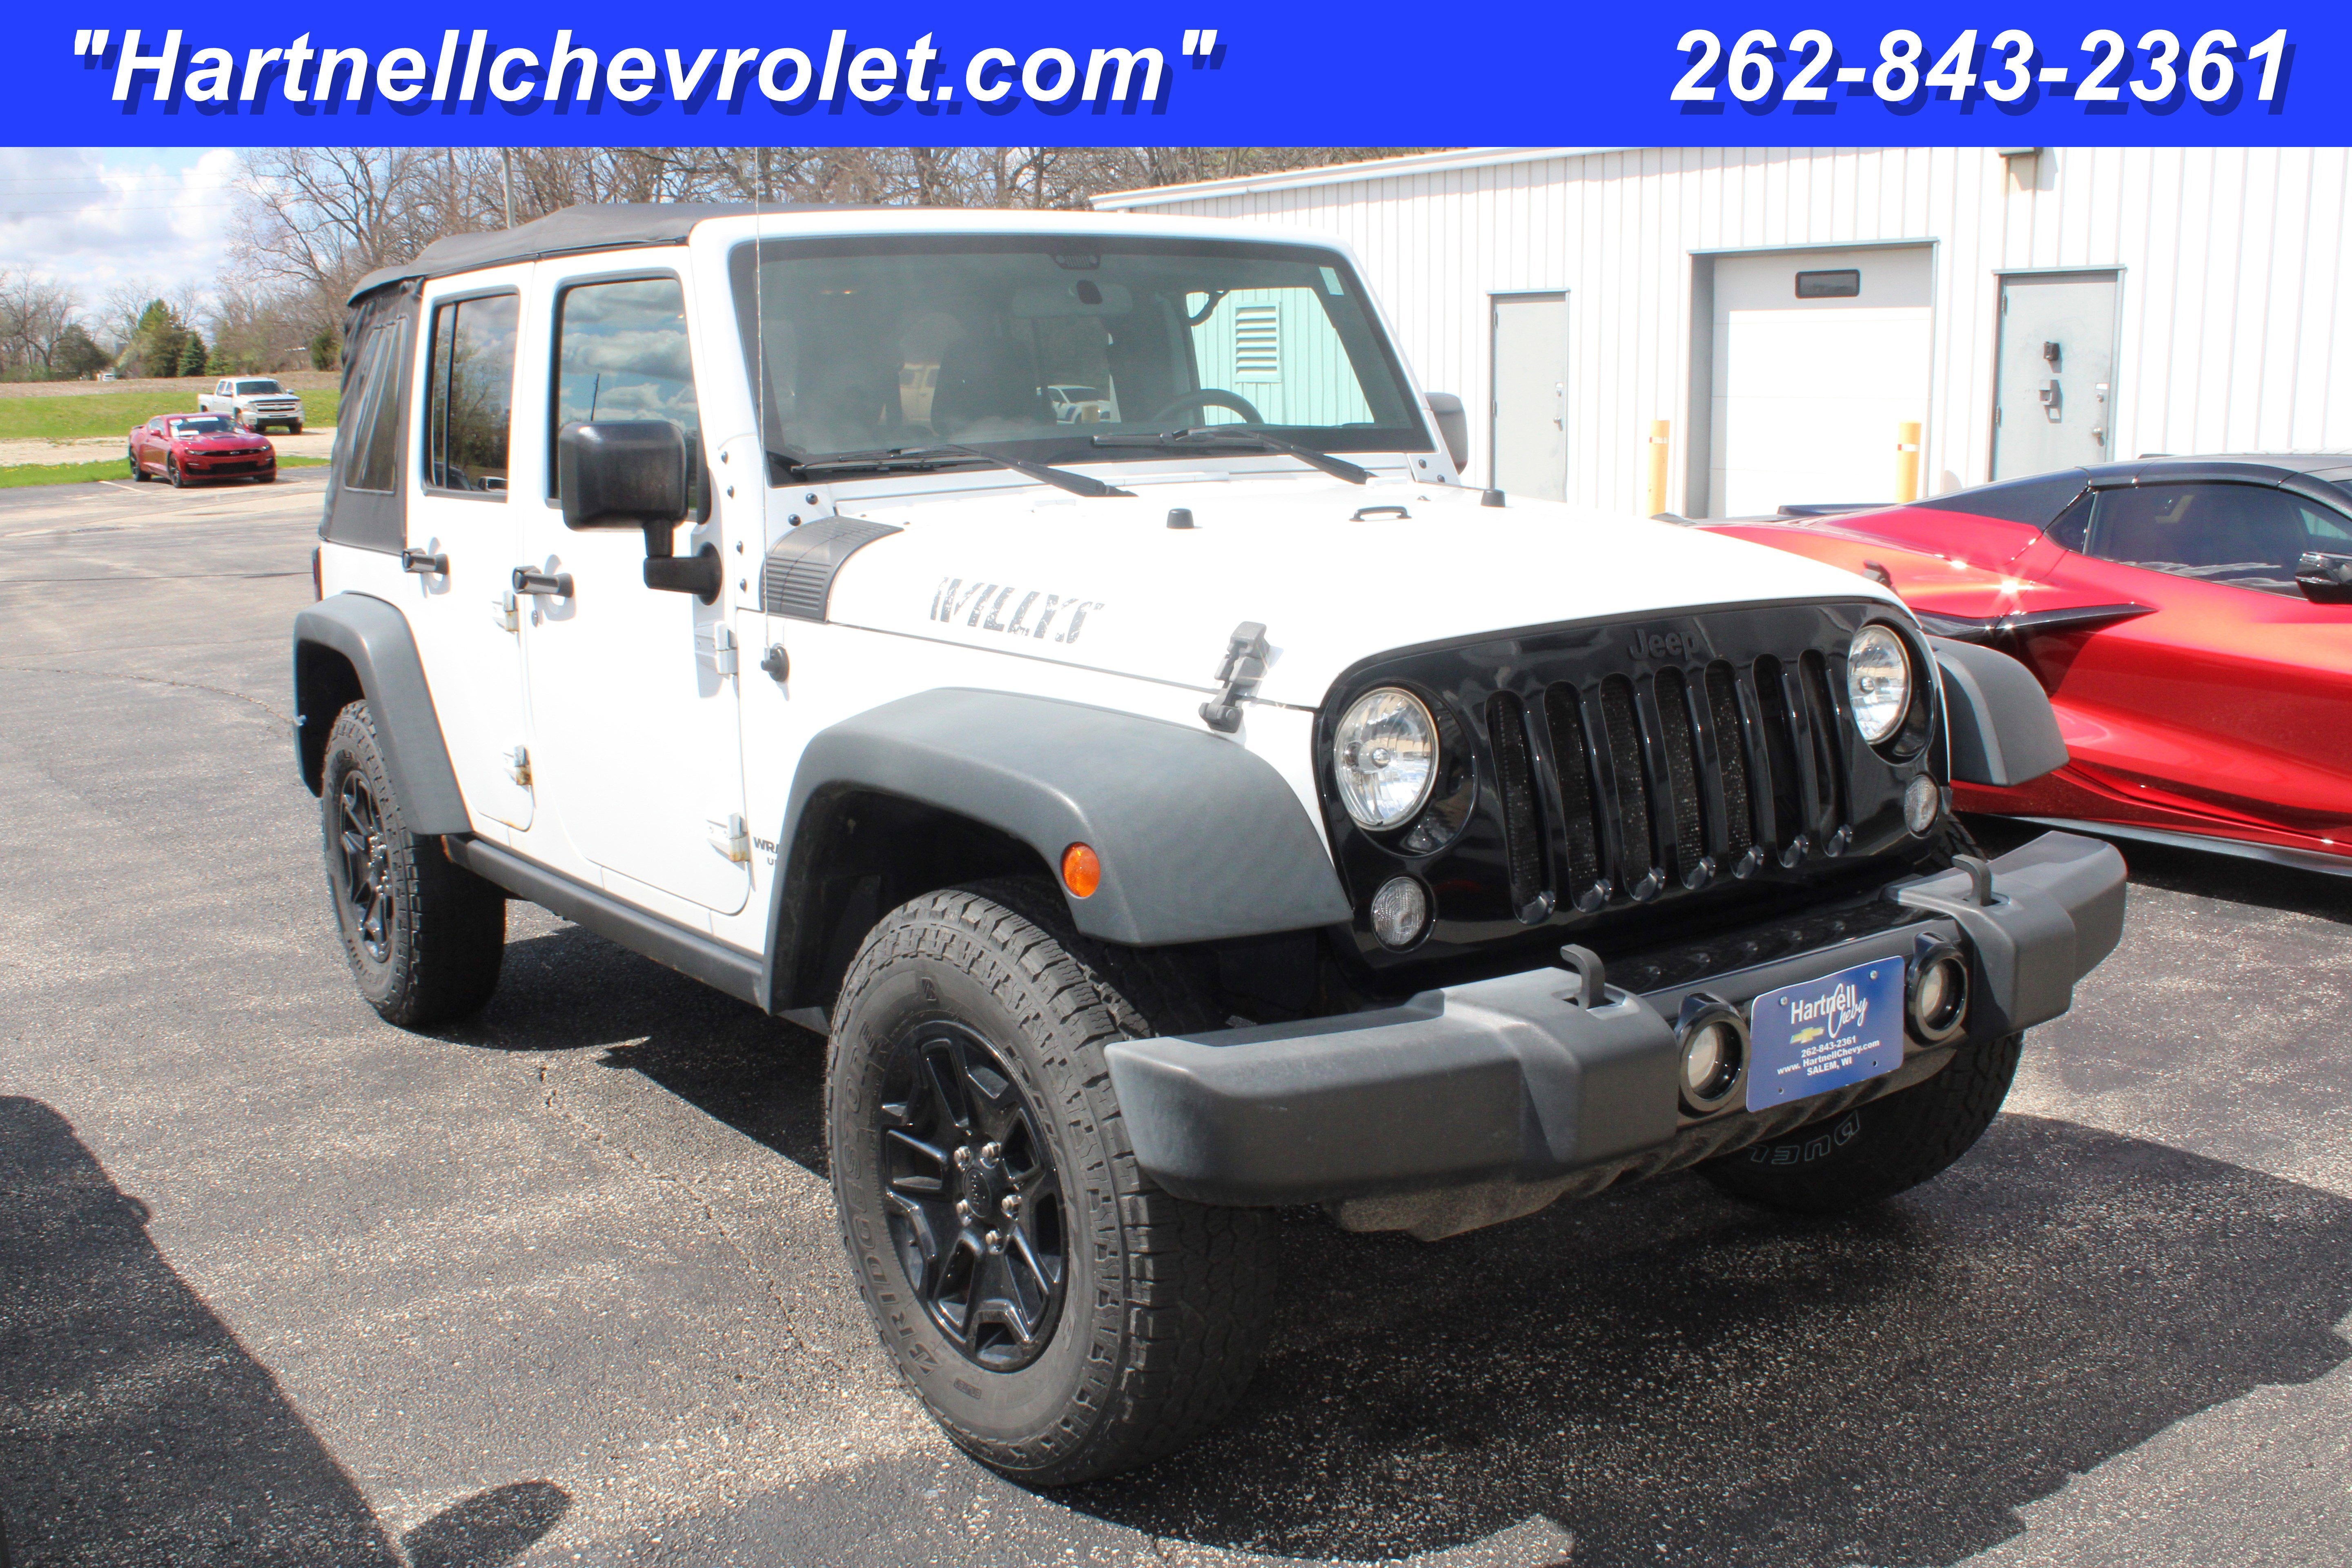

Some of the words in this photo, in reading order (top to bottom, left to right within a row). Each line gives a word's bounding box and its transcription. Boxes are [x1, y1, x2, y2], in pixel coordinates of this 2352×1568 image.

[930, 576, 1106, 644] WILLYS
[1627, 629, 1699, 661] Jeep
[1791, 984, 1856, 1025] Hartnell
[1828, 982, 1869, 1038] Chevy
[1777, 1062, 1801, 1075] www.
[1802, 1040, 1880, 1067] HartnellChevy.com
[1801, 1035, 1857, 1058] 262-843-2361
[1806, 1060, 1840, 1076] SALEM,
[1841, 1056, 1852, 1066] WI
[842, 1020, 942, 1376] BRIDGESTONE
